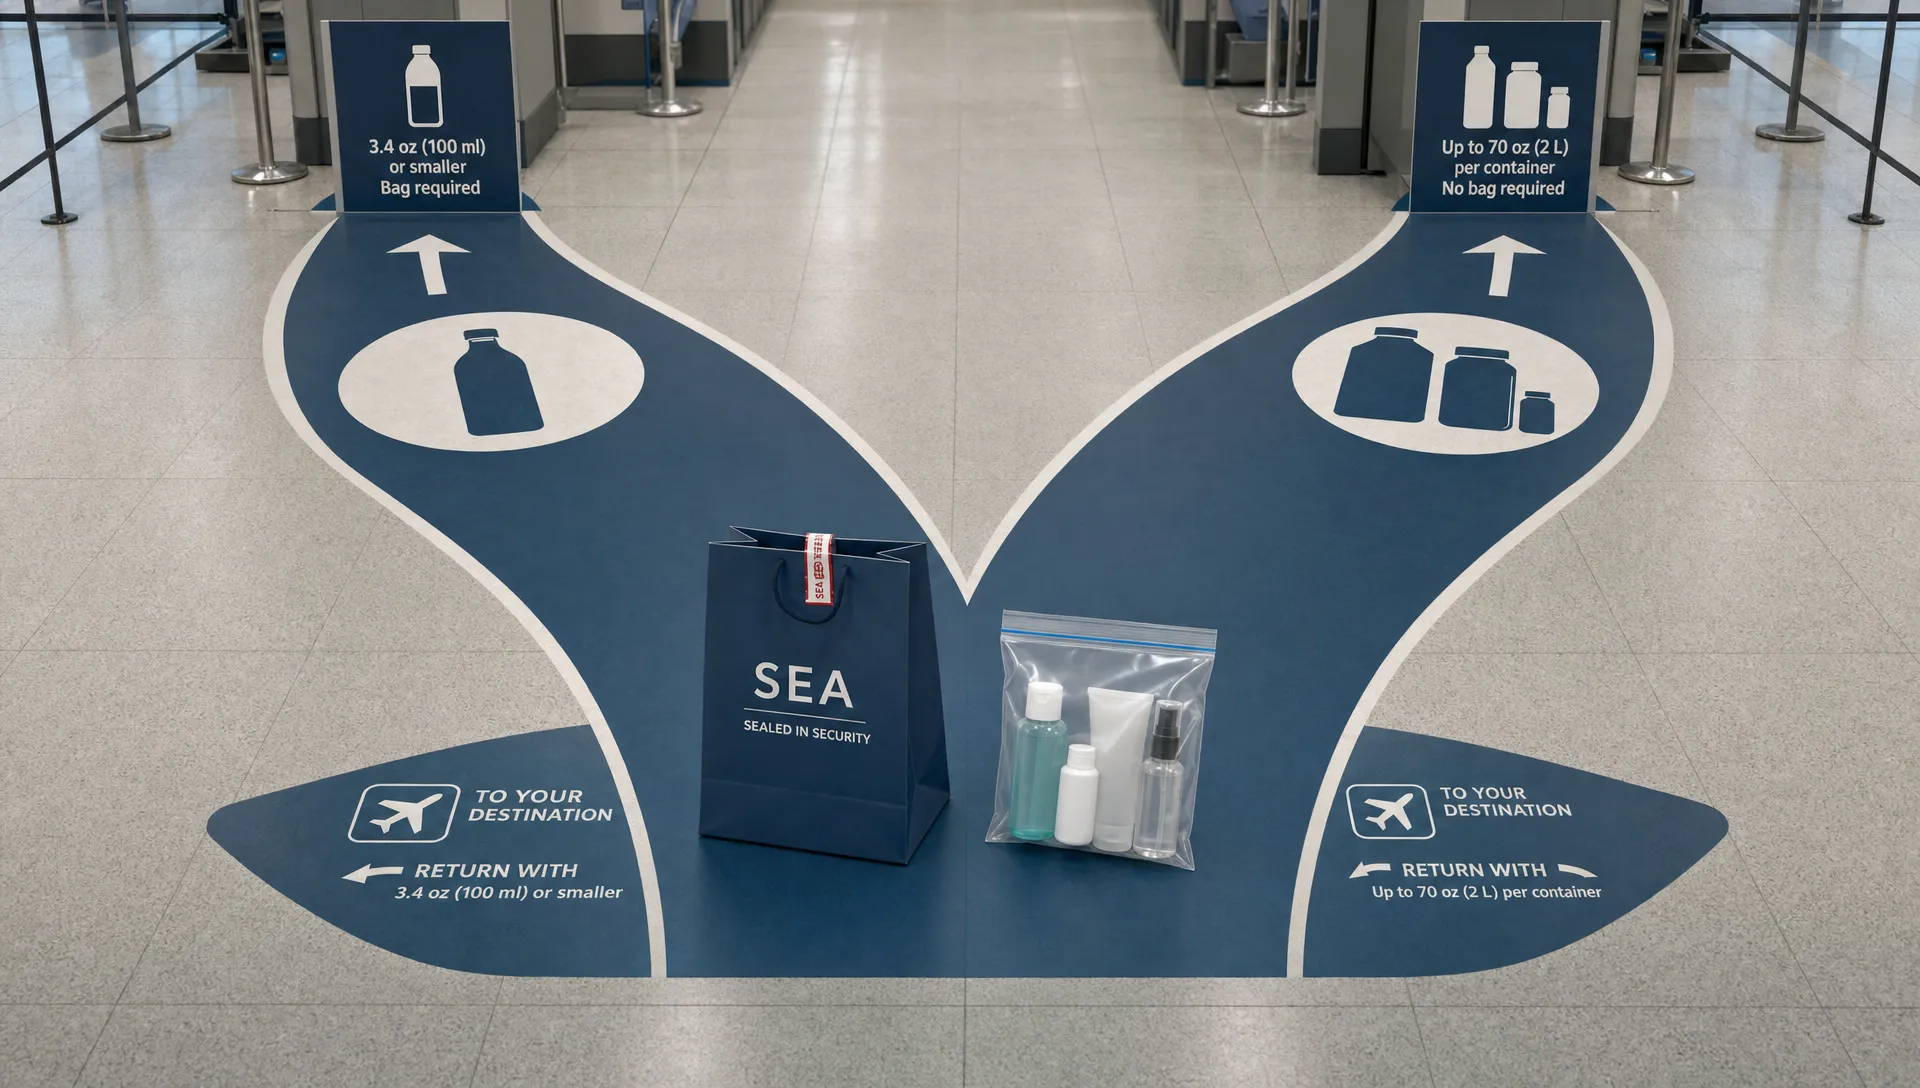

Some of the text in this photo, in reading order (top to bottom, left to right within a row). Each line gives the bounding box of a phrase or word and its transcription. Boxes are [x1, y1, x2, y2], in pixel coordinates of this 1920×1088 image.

[369, 138, 486, 156] 3.4 oz (100 ml)
[1442, 139, 1569, 157] Up to 70 oz (2 L)
[389, 159, 467, 174] or smaller
[1454, 160, 1556, 178] per container
[380, 180, 481, 198] Bag required
[1442, 180, 1565, 199] No bag required
[754, 661, 853, 709] SEA
[744, 720, 871, 745] SEALED IN SECURITY
[475, 789, 583, 803] TO YOUR
[1440, 787, 1527, 800] TO YOUR
[468, 808, 613, 822] DESTINATION
[1444, 804, 1572, 817] DESTINATION
[414, 864, 578, 878] RETURN WITH
[1402, 863, 1547, 877] RETURN WITH
[394, 885, 623, 901] 3.4 oz (100 ml) or smaller
[1372, 885, 1602, 900] Up to 70 oz (2 L) per container
